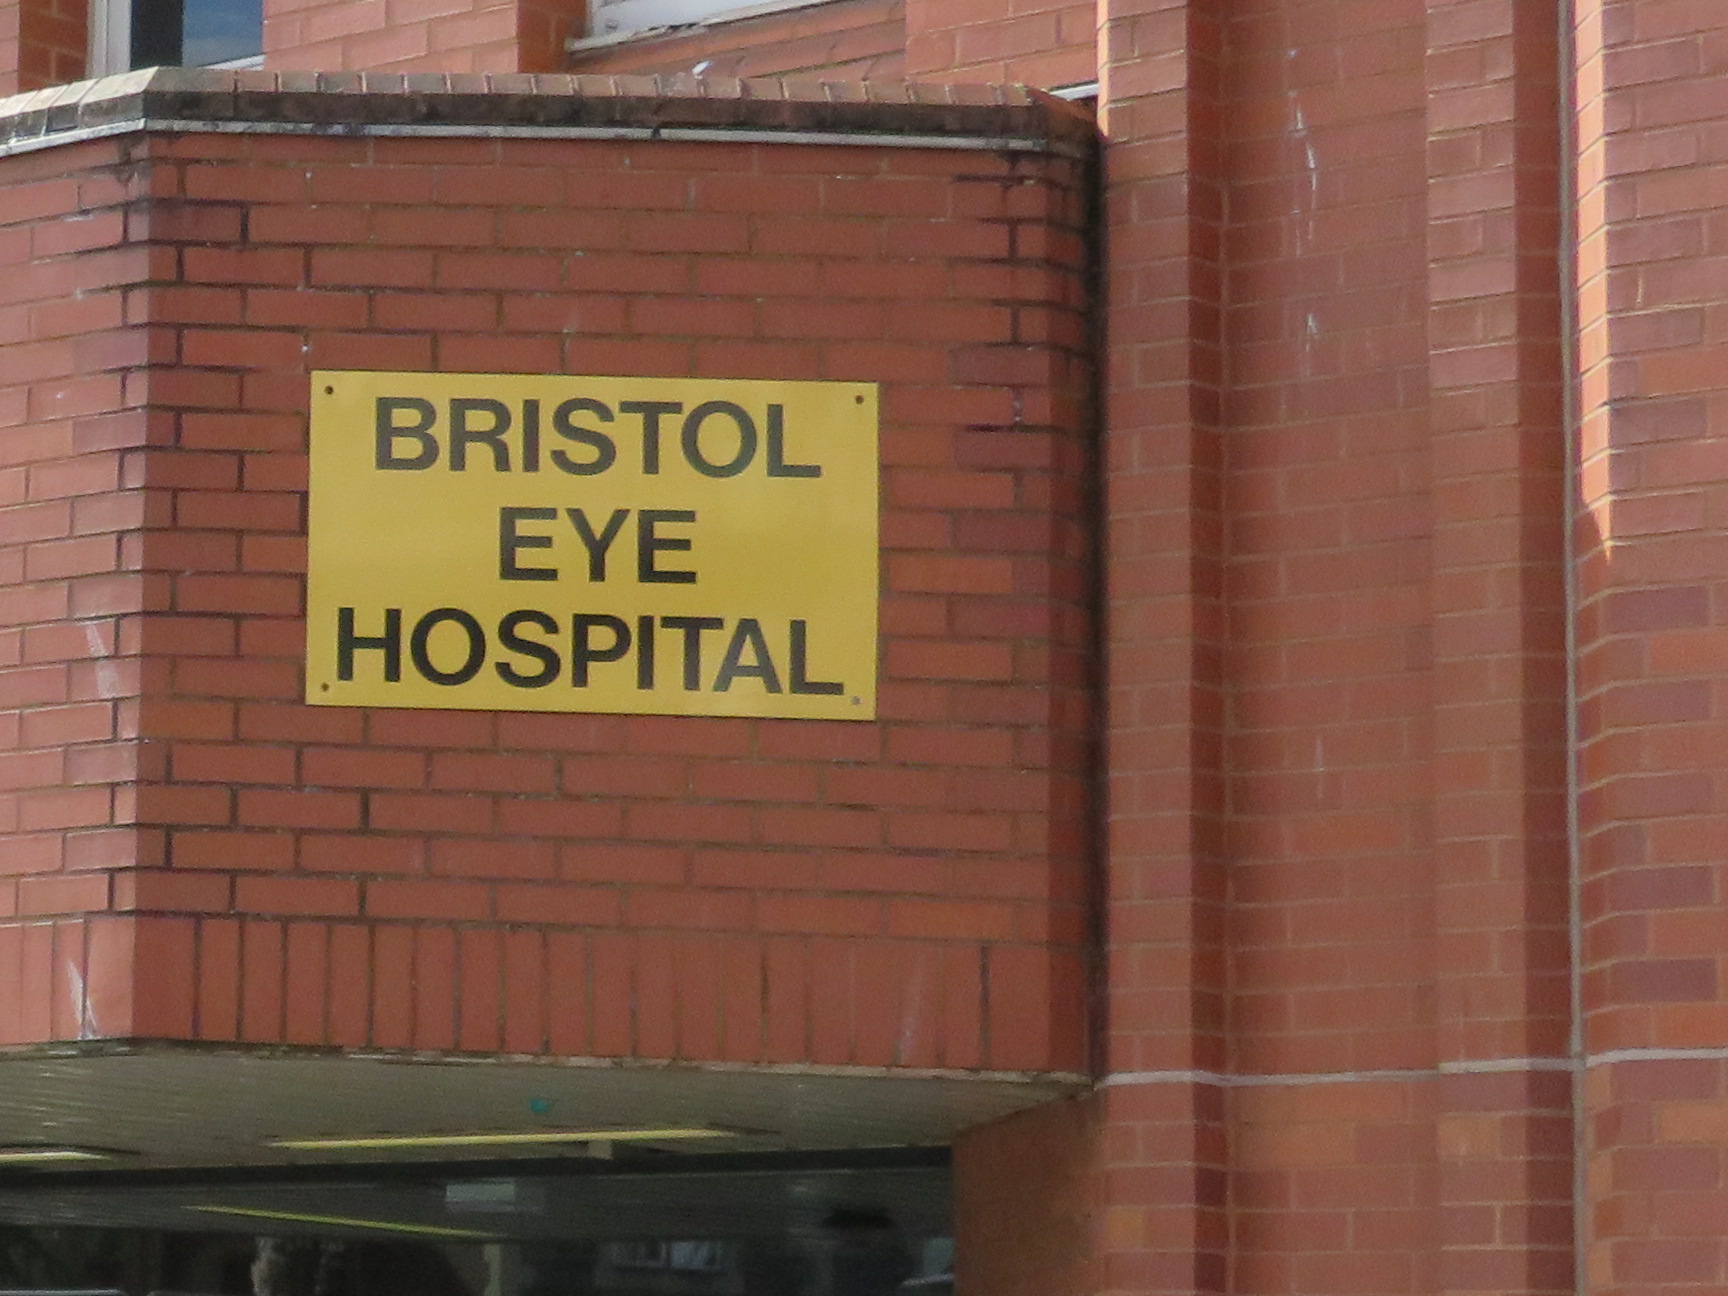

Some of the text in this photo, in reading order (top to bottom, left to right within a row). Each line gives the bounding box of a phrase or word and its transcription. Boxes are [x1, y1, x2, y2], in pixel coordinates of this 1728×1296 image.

[374, 396, 822, 479] BRISTOL
[499, 506, 698, 585] EYE
[336, 606, 845, 697] HOSPITAL
